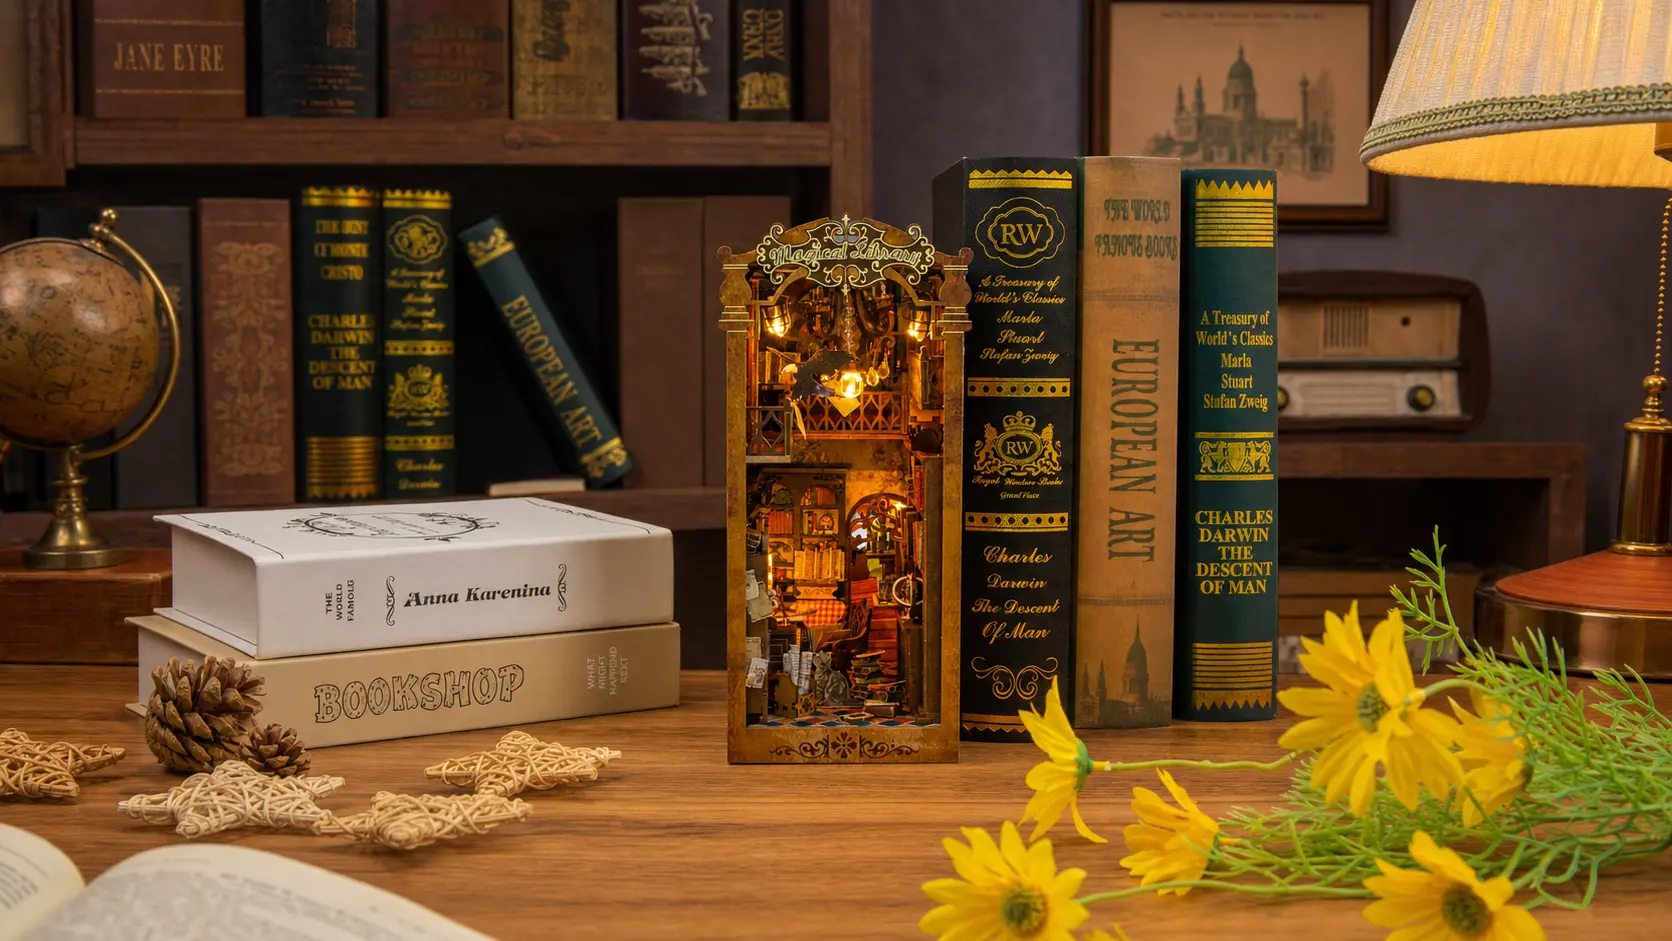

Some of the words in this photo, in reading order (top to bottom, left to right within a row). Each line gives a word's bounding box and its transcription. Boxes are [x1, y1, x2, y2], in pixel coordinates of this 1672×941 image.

[114, 43, 164, 71] JANE
[174, 44, 224, 72] EYRE
[1001, 223, 1043, 246] RW
[308, 314, 376, 328] CHARLES
[1201, 310, 1210, 325] A
[1212, 310, 1258, 329] Treasury
[1260, 310, 1270, 325] of
[311, 331, 373, 344] DARWIN
[1240, 330, 1274, 346] Classics
[330, 347, 360, 360] THE
[308, 361, 376, 374] DESCENT
[501, 294, 579, 405] EUROPEAN
[560, 406, 604, 448] ART
[312, 376, 335, 390] OF
[337, 376, 372, 390] MAN
[1221, 373, 1253, 388] Stuart
[1239, 394, 1268, 412] Zweig
[1109, 338, 1160, 494] EUROPEAN
[1006, 441, 1034, 455] RW
[1195, 510, 1273, 525] CHARLES
[1107, 506, 1156, 563] ART
[1199, 528, 1269, 543] DARWIN
[983, 545, 1052, 564] Charles
[1218, 545, 1253, 560] THE
[1196, 562, 1272, 577] DESCENT
[987, 573, 1047, 589] Darwin
[1200, 580, 1225, 594] OF
[1228, 580, 1267, 594] MAN
[325, 592, 333, 614] THE
[403, 592, 459, 607] Anna
[465, 584, 551, 602] Karenina
[971, 597, 1001, 614] The
[1004, 598, 1060, 615] Descent
[982, 620, 1005, 645] Of
[1005, 621, 1050, 639] Man
[314, 664, 524, 723] BOOKSHOP
